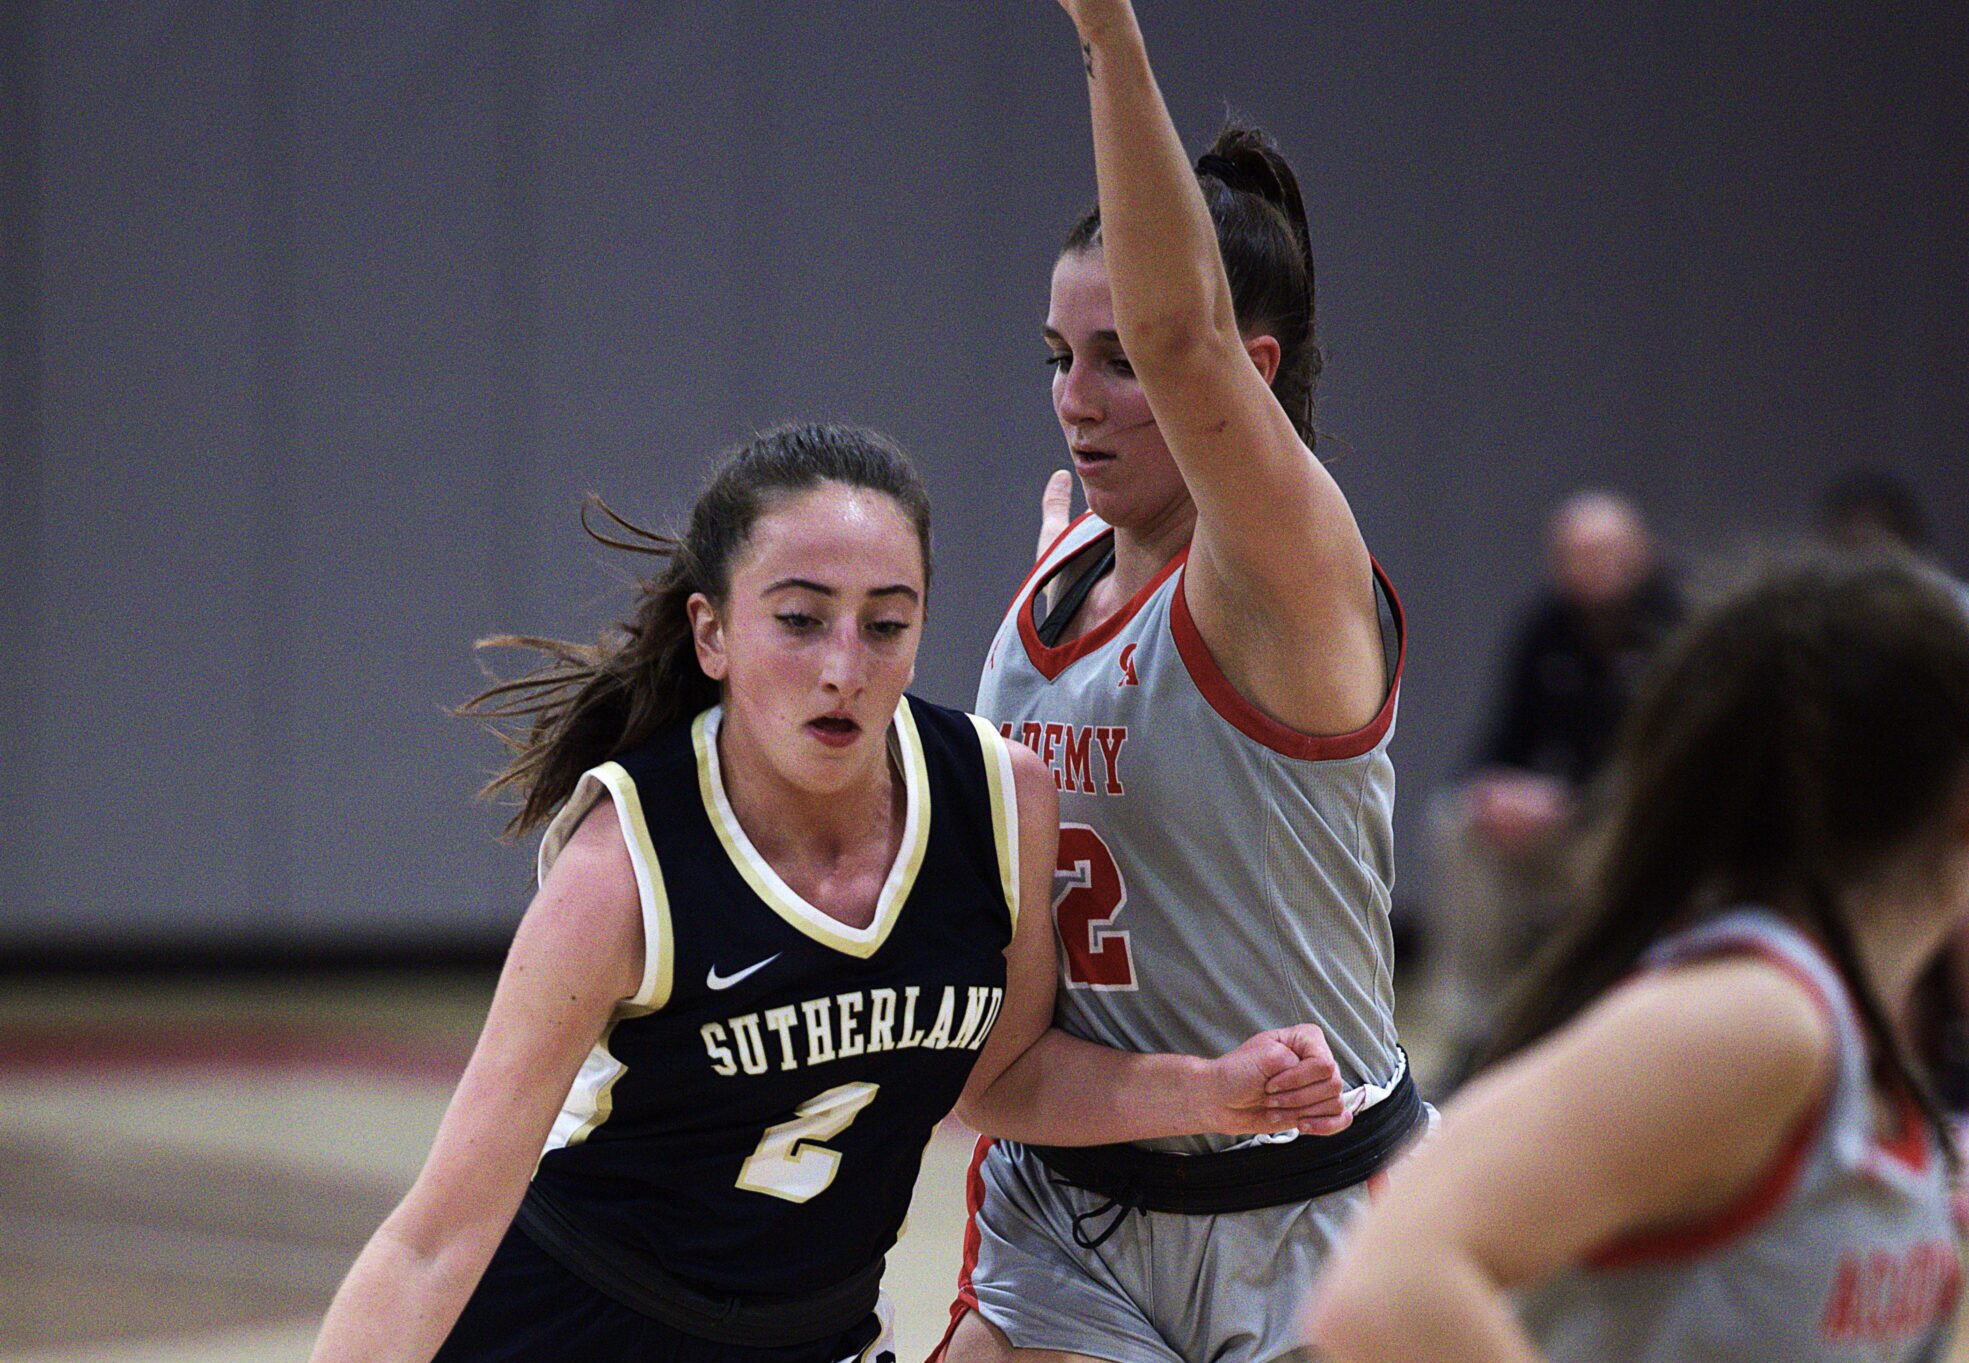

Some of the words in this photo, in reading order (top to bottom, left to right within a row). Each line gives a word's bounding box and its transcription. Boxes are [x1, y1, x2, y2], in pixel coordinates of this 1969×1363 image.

[999, 721, 1128, 796] EMY
[1052, 821, 1139, 992] 2
[700, 985, 1003, 1076] SUTHERLAND
[734, 1081, 880, 1204] 2
